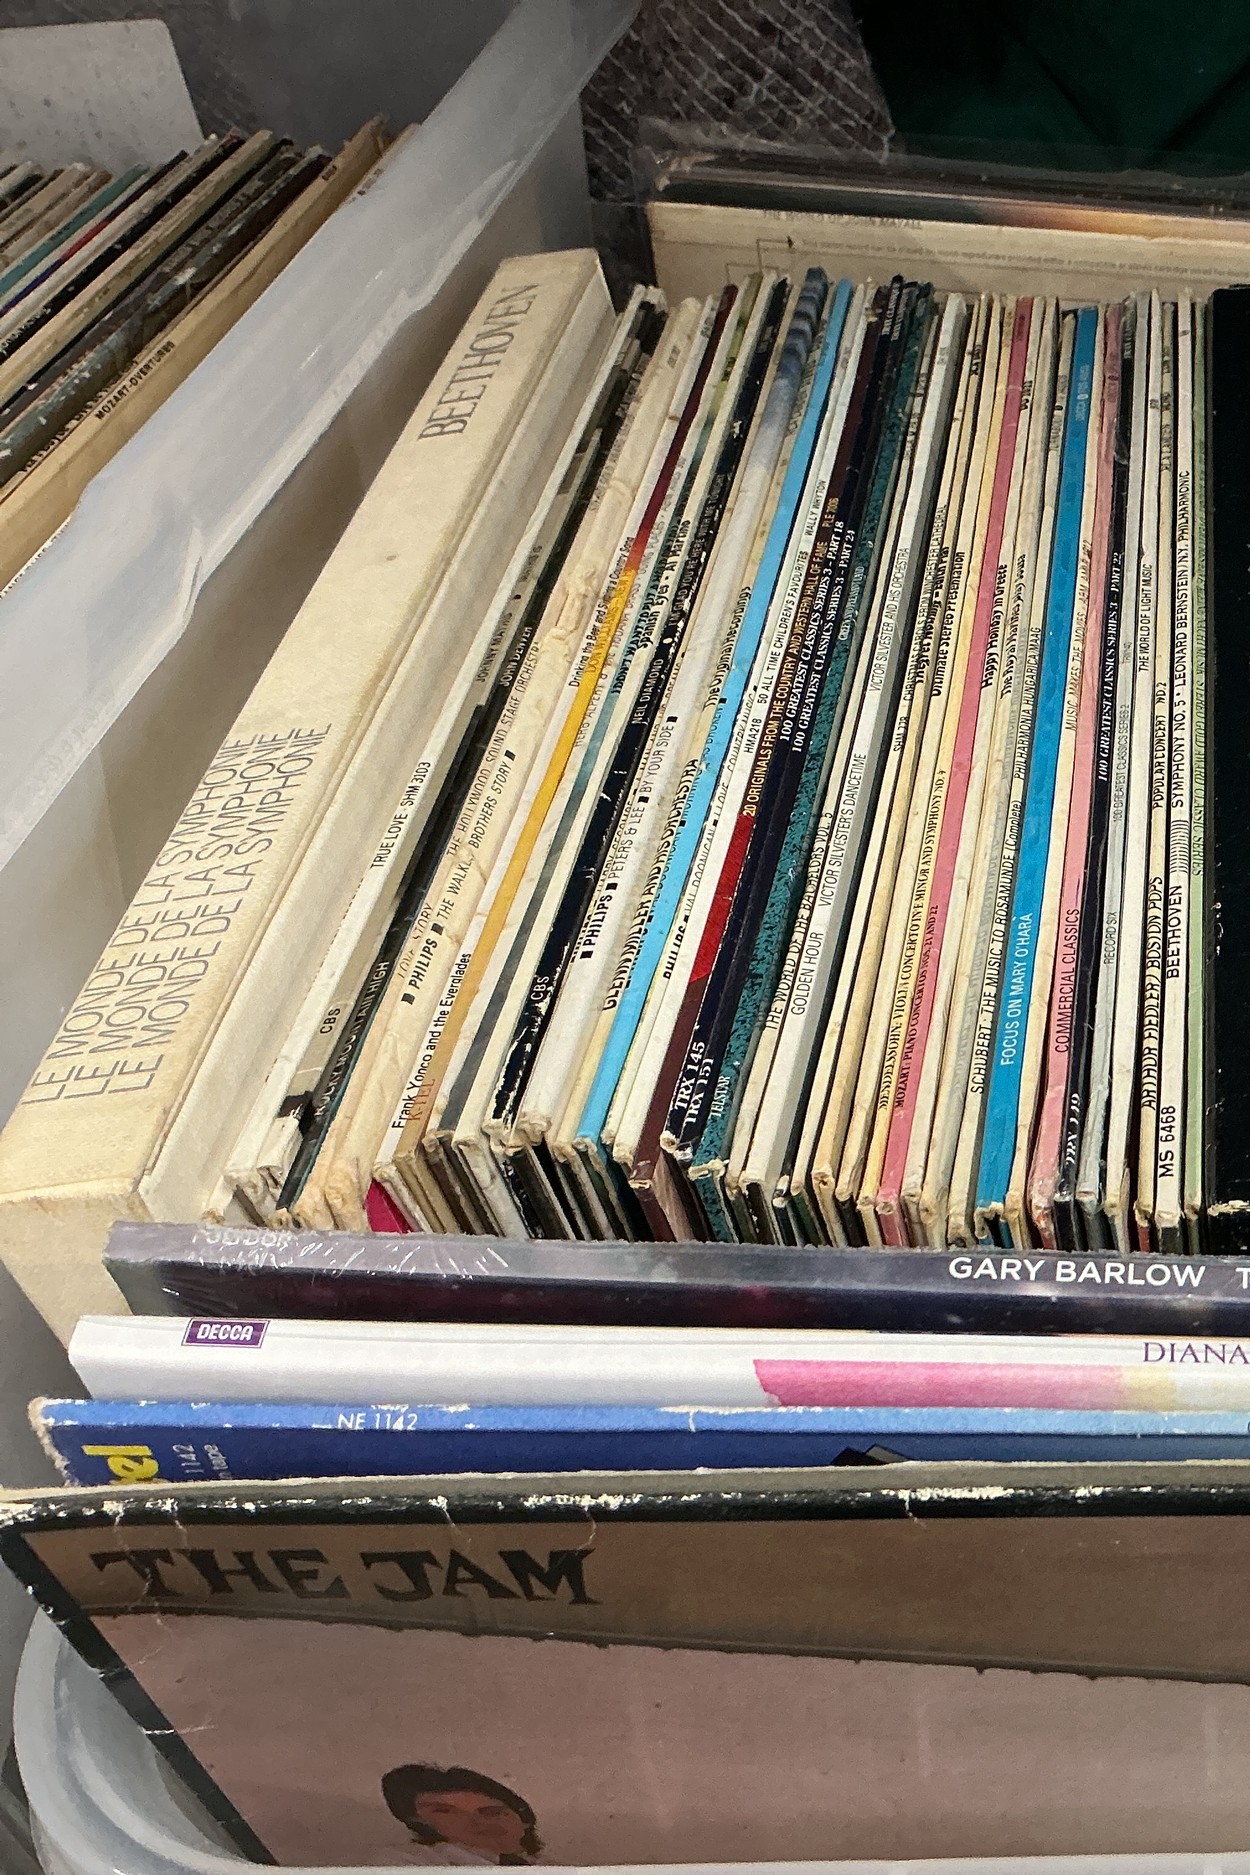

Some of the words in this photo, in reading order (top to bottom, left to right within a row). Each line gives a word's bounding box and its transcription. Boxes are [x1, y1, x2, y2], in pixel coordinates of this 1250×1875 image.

[417, 283, 539, 440] BEETHOVEN
[636, 610, 668, 648] Spanish
[668, 519, 692, 557] Martino
[771, 598, 795, 648] CHILDREN'S
[1106, 610, 1118, 641] SERIES
[497, 661, 520, 686] JOHN
[638, 658, 665, 702] DIAMOND
[765, 651, 781, 671] TIME
[784, 661, 810, 717] GREATEST
[800, 611, 822, 660] CLASSICS
[797, 672, 822, 729] GREATEST
[812, 621, 834, 670] CLASSICS
[868, 662, 886, 691] VICTOR
[981, 652, 998, 687] Happy
[1138, 655, 1149, 671] THE
[745, 748, 774, 802] ORIGINALS
[761, 719, 781, 746] FROM
[775, 656, 799, 698] COUNTRY
[194, 728, 297, 862] SYMPHONIE
[233, 722, 333, 856] SYMPHONIE
[842, 753, 867, 806] DANCETIME
[155, 734, 259, 869] SYMPHONIE
[369, 842, 395, 868] TRUE
[383, 813, 409, 840] LOVE
[409, 761, 432, 783] 3103
[582, 894, 614, 946] PHILIPS
[608, 837, 634, 878] PETERS
[644, 749, 666, 778] YOUR
[656, 725, 674, 747] SIDE
[827, 808, 854, 867] SILVESTER'S
[133, 870, 178, 907] LA
[172, 862, 222, 901] LA
[212, 858, 263, 896] LA
[406, 938, 440, 989] PHILIPS
[465, 795, 500, 848] BROTHERS
[488, 760, 515, 793] STORY
[601, 957, 631, 1010] GLENN
[620, 899, 652, 955] MILLER
[658, 758, 698, 840] ORCHESTRA
[818, 868, 839, 906] VICTOR
[109, 910, 161, 948] DE
[149, 904, 204, 942] DE
[190, 897, 244, 937] DE
[1061, 908, 1079, 963] CLASSICS
[1166, 884, 1182, 979] BEETHOVEN
[802, 931, 824, 965] HOUR
[1103, 926, 1116, 964] RECORD
[366, 961, 391, 992] HIGH
[528, 975, 550, 1000] CBS
[771, 957, 797, 1003] WORLD
[985, 947, 1003, 986] MUSIC
[46, 952, 138, 1060] MONDE
[88, 946, 180, 1054] MONDE
[132, 940, 222, 1048] MONDE
[789, 968, 815, 1015] GOLDEN
[999, 1020, 1019, 1064] FOCUS
[1009, 961, 1026, 995] MARY
[1054, 967, 1075, 1052] COMMERCIAL
[318, 1007, 343, 1033] CBS
[391, 1094, 417, 1128] Frank
[407, 1053, 433, 1089] Yonco
[439, 953, 473, 1006] Everglades
[902, 1027, 918, 1060] PIANO
[20, 1064, 76, 1105] LE
[63, 1060, 121, 1100] LE
[107, 1053, 165, 1094] LE
[673, 1074, 696, 1109] TRX
[685, 1041, 706, 1072] 145
[696, 1057, 715, 1085] 151
[877, 1023, 903, 1109] MENDELSSOHN:
[1140, 1045, 1157, 1109] ARTHUR
[406, 1078, 437, 1120] K-TEL
[708, 1075, 731, 1117] TELSTAR
[1159, 1105, 1175, 1142] 6468
[948, 1256, 1046, 1282] GARY
[1055, 1260, 1207, 1288] BARLOW
[196, 1323, 254, 1342] DECCA
[1142, 1341, 1250, 1367] DIANA
[337, 1413, 366, 1430] NE
[374, 1412, 418, 1431] 1142
[171, 1443, 206, 1475] 1142
[90, 1548, 350, 1599] THE
[360, 1547, 602, 1604] JAM
